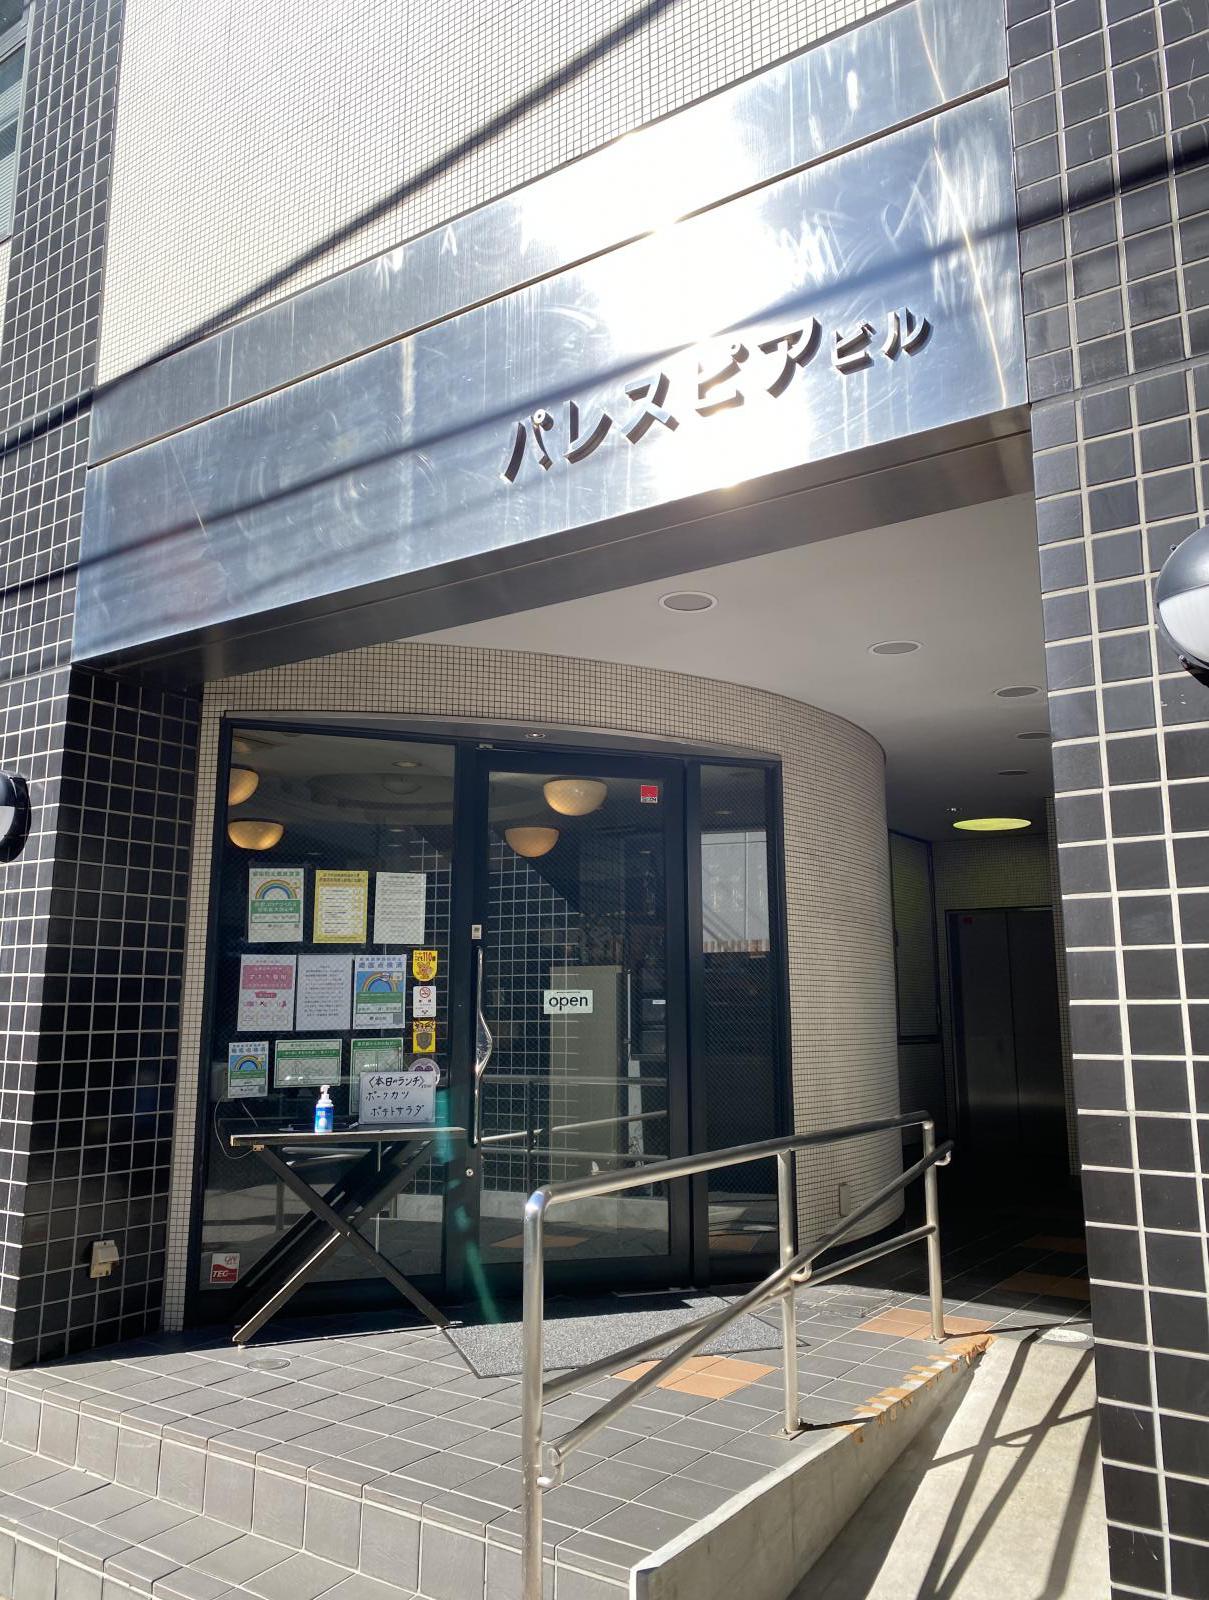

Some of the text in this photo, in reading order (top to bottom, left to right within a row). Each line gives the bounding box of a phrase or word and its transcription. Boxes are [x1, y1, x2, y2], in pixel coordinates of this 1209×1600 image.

[501, 306, 932, 484] パレスピアビル
[549, 996, 588, 1011] open
